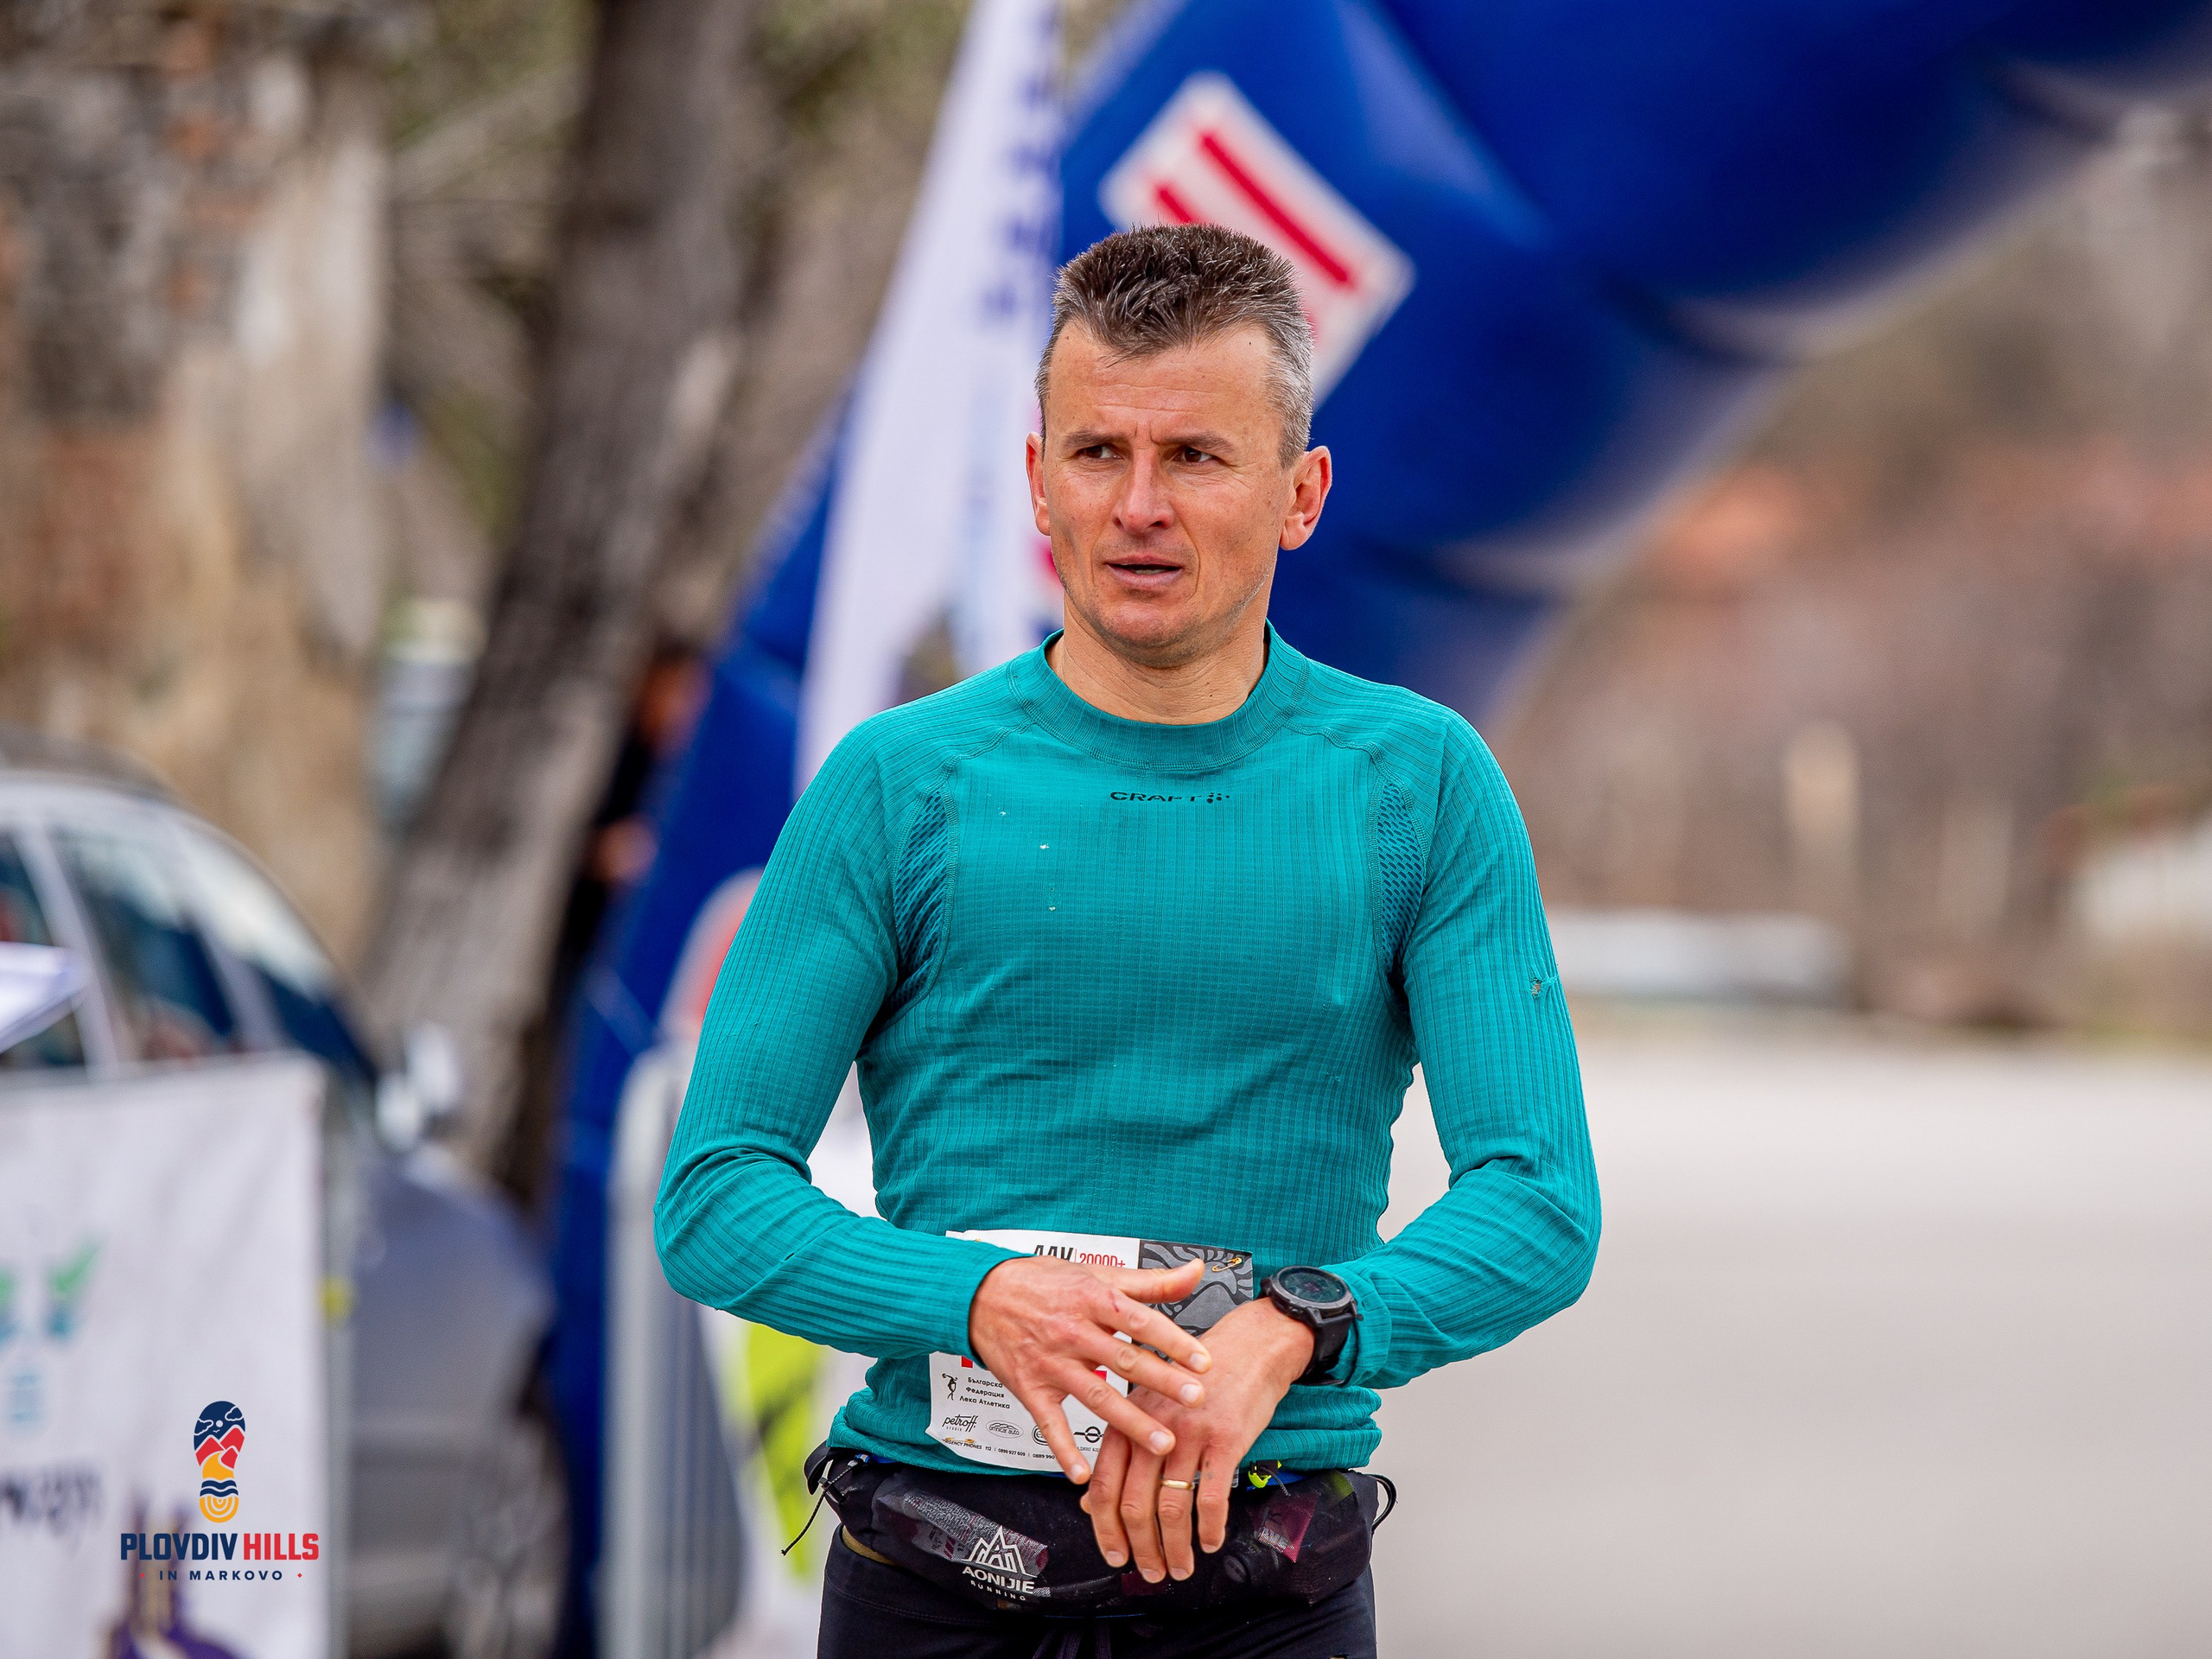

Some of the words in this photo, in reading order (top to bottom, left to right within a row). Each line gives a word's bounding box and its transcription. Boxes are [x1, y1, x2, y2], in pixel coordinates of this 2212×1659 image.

[1109, 791, 1203, 802] CRAFT
[959, 1395, 977, 1403] Лека
[978, 1398, 1010, 1409] Атлетика
[962, 1565, 1035, 1594] AONIJIE
[969, 1580, 1027, 1601] RUNNING
